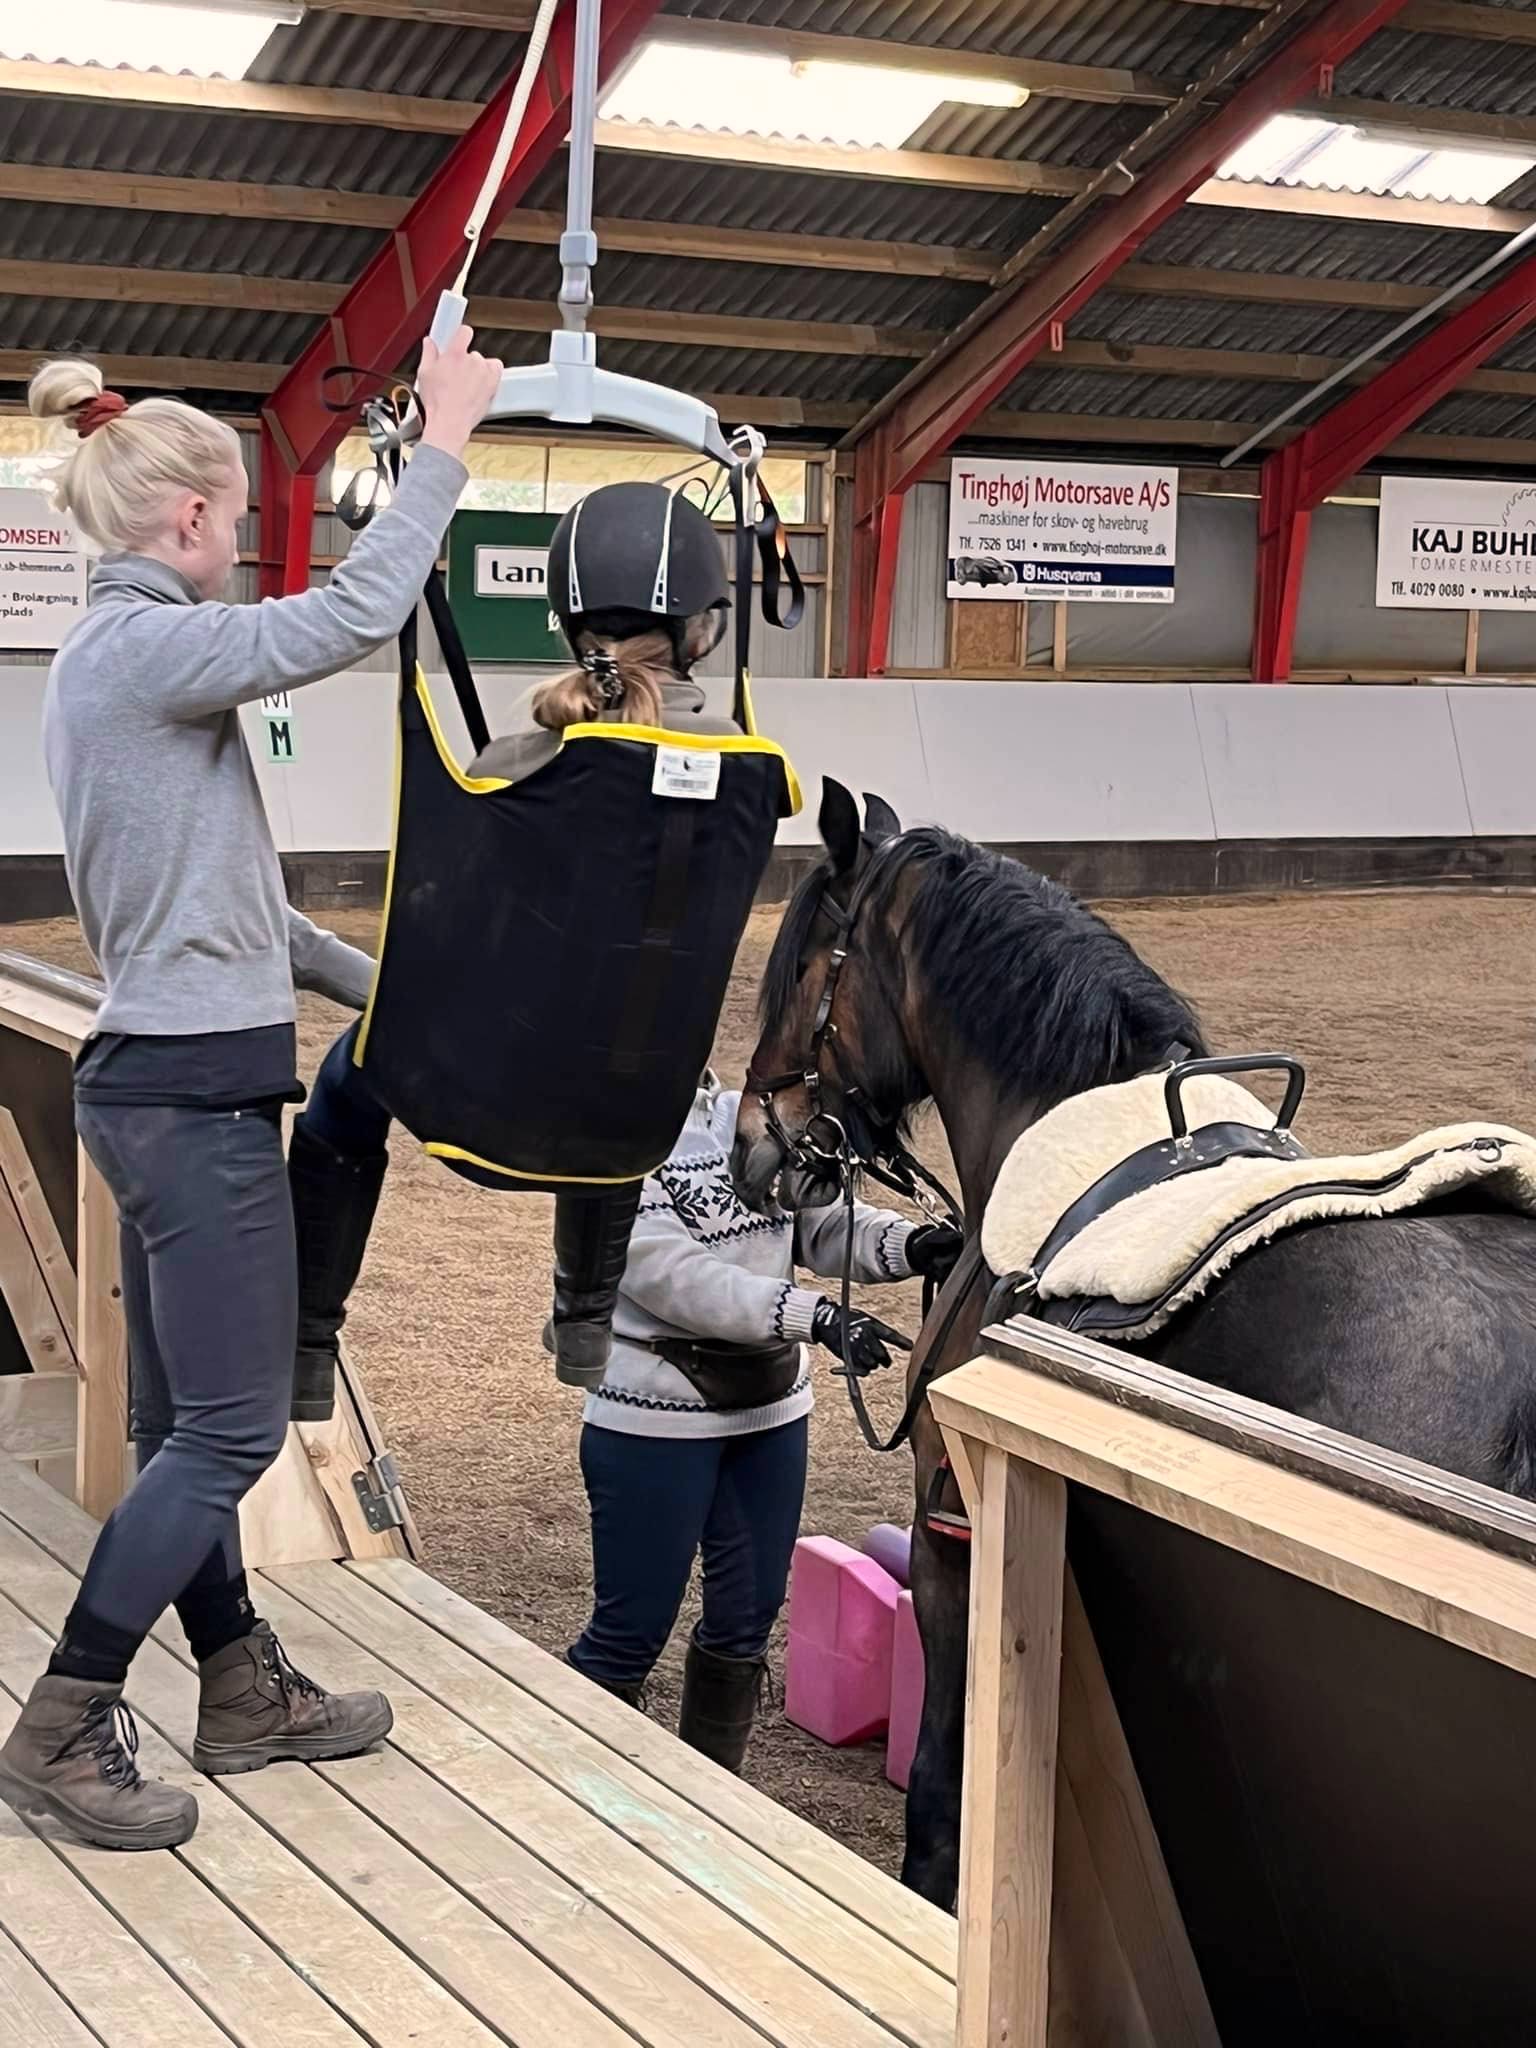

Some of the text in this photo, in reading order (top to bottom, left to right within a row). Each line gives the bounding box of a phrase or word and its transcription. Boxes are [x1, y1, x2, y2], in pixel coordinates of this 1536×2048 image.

[959, 473, 1171, 512] Tinghøj Motorsave A/S
[1033, 511, 1049, 528] for
[1051, 513, 1079, 529] skov-
[1082, 518, 1095, 533] og
[1098, 514, 1149, 535] havebrug
[979, 537, 1001, 551] 7526
[1006, 538, 1026, 551] 1341
[1412, 528, 1463, 553] KAJ
[1037, 567, 1102, 584] Husqvarna
[12, 592, 79, 606] Brolægning
[1410, 583, 1436, 597] 4029
[1439, 584, 1465, 598] 0080
[269, 720, 293, 756] M
